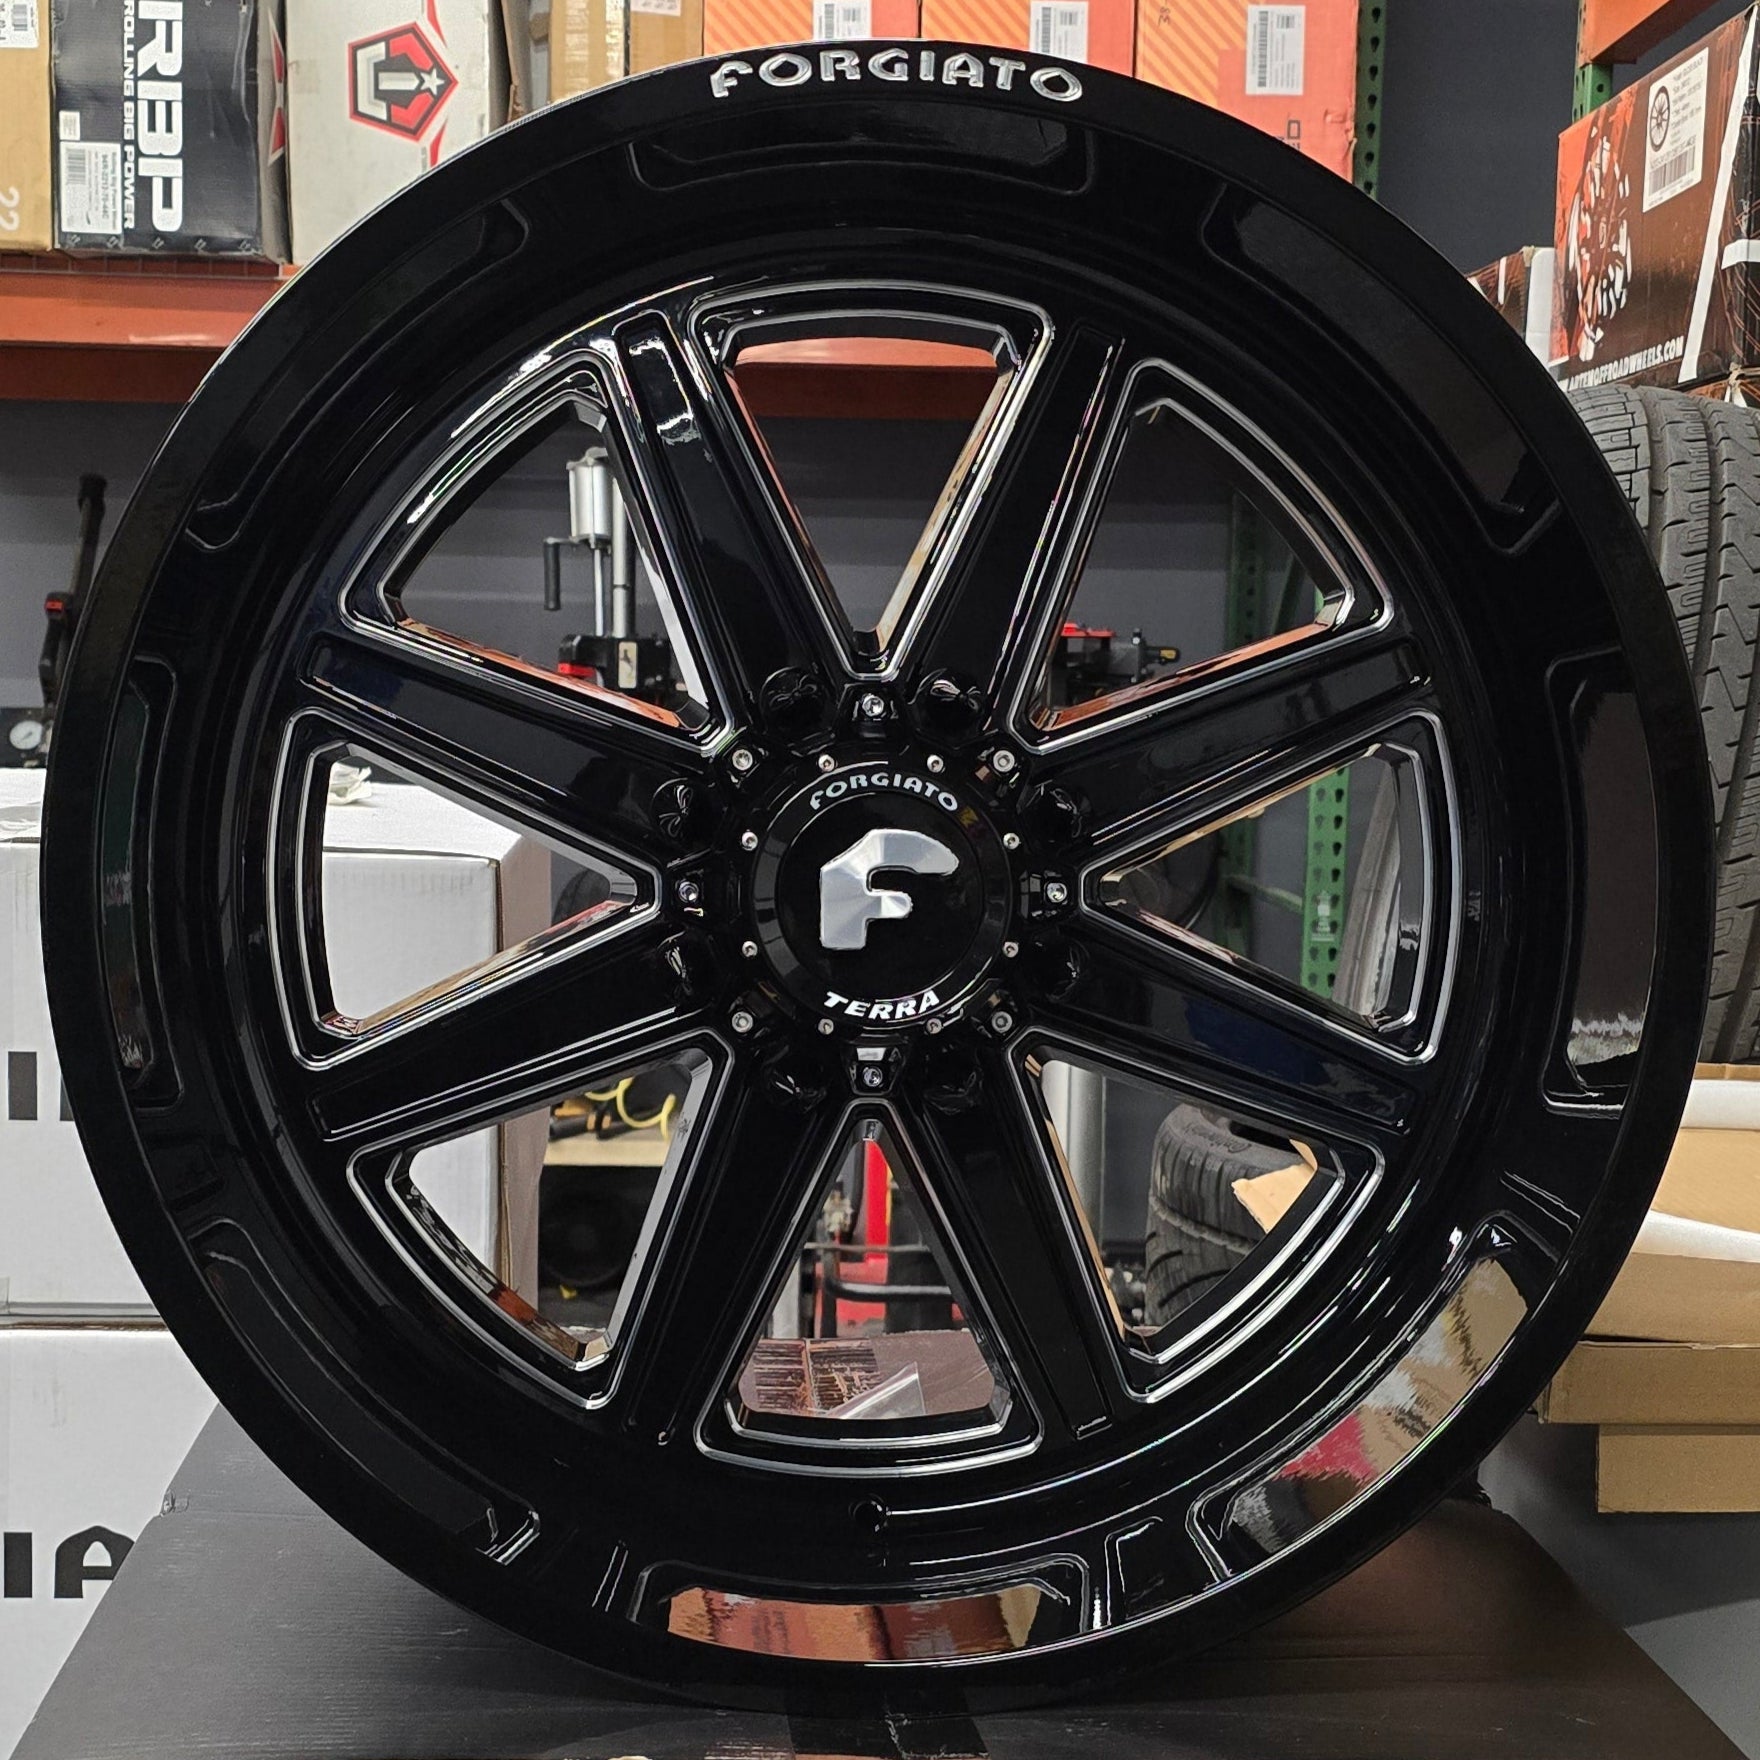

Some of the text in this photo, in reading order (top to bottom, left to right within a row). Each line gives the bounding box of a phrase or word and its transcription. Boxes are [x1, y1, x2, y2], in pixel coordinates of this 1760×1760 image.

[709, 48, 1082, 101] FORGIATO
[123, 0, 135, 229] ROLLING BIG POWER
[138, 1, 182, 232] RBP
[809, 772, 958, 811] FORGIATO
[823, 991, 940, 1020] TERRA
